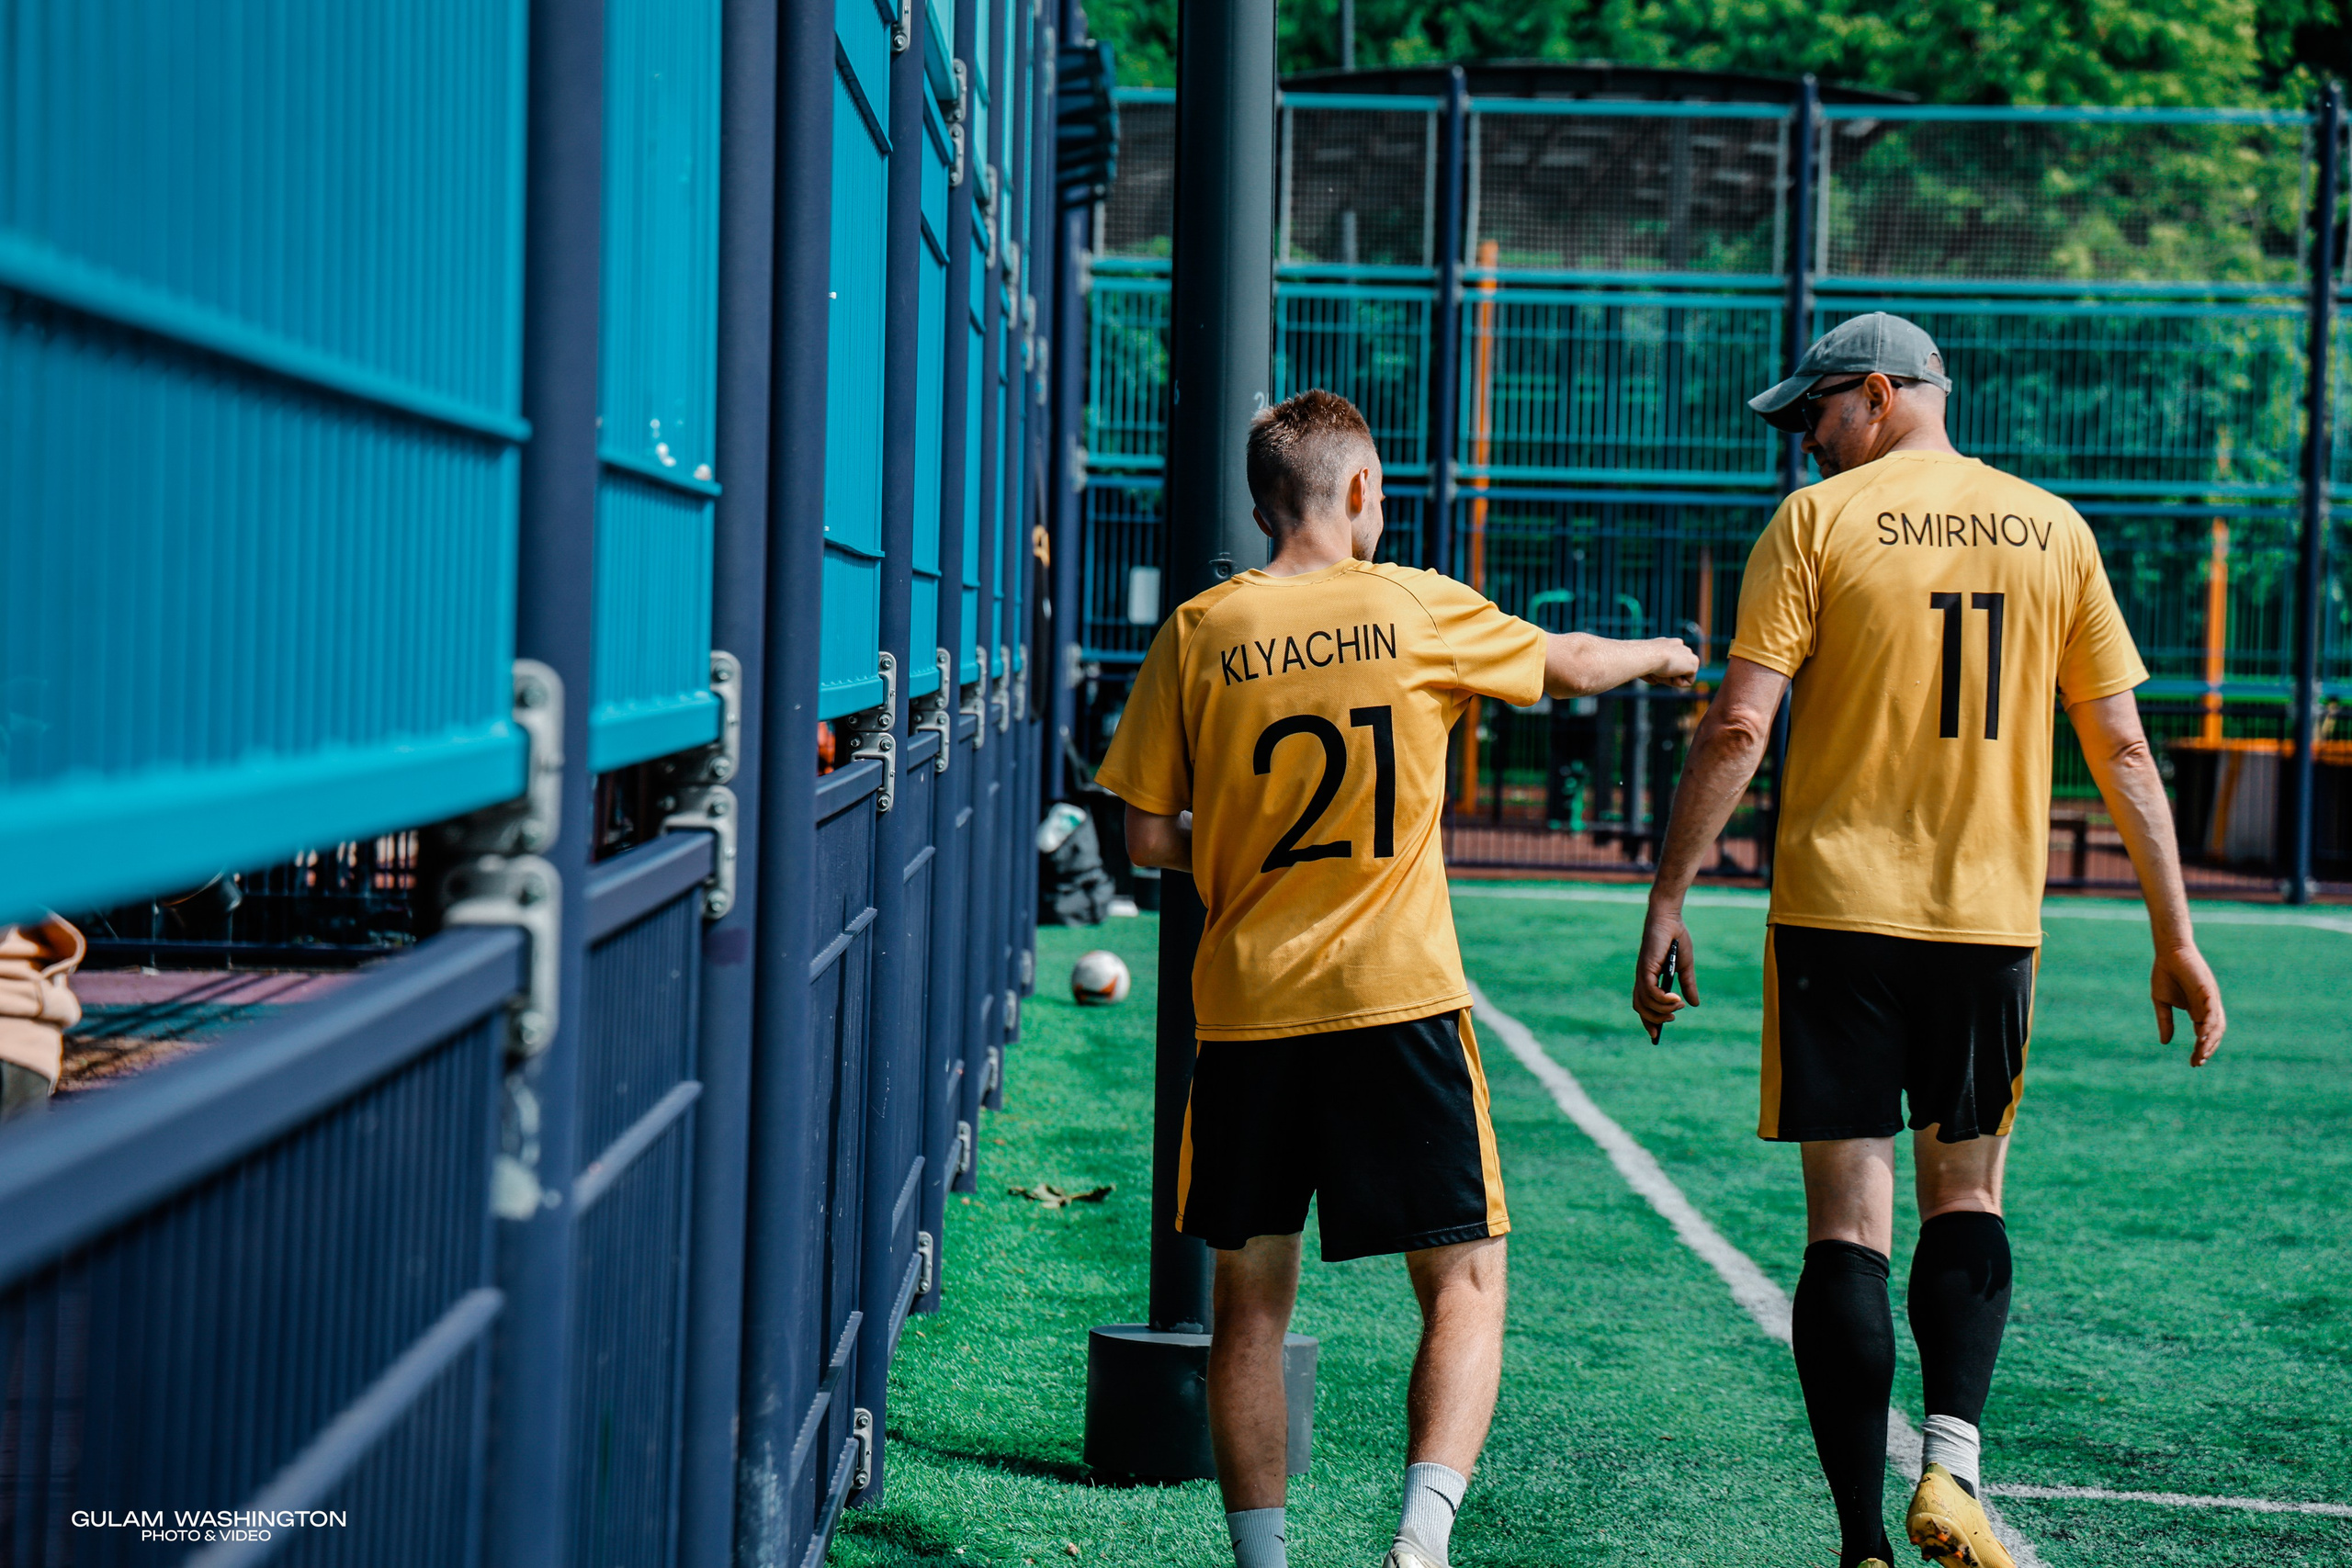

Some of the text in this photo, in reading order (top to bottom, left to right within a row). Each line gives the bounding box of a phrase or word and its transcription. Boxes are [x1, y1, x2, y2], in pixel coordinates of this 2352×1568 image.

[1877, 512, 2052, 551] SMIRNOV
[1220, 623, 1396, 687] KLYACHIN
[1929, 592, 2005, 740] 11
[1253, 705, 1396, 874] 21
